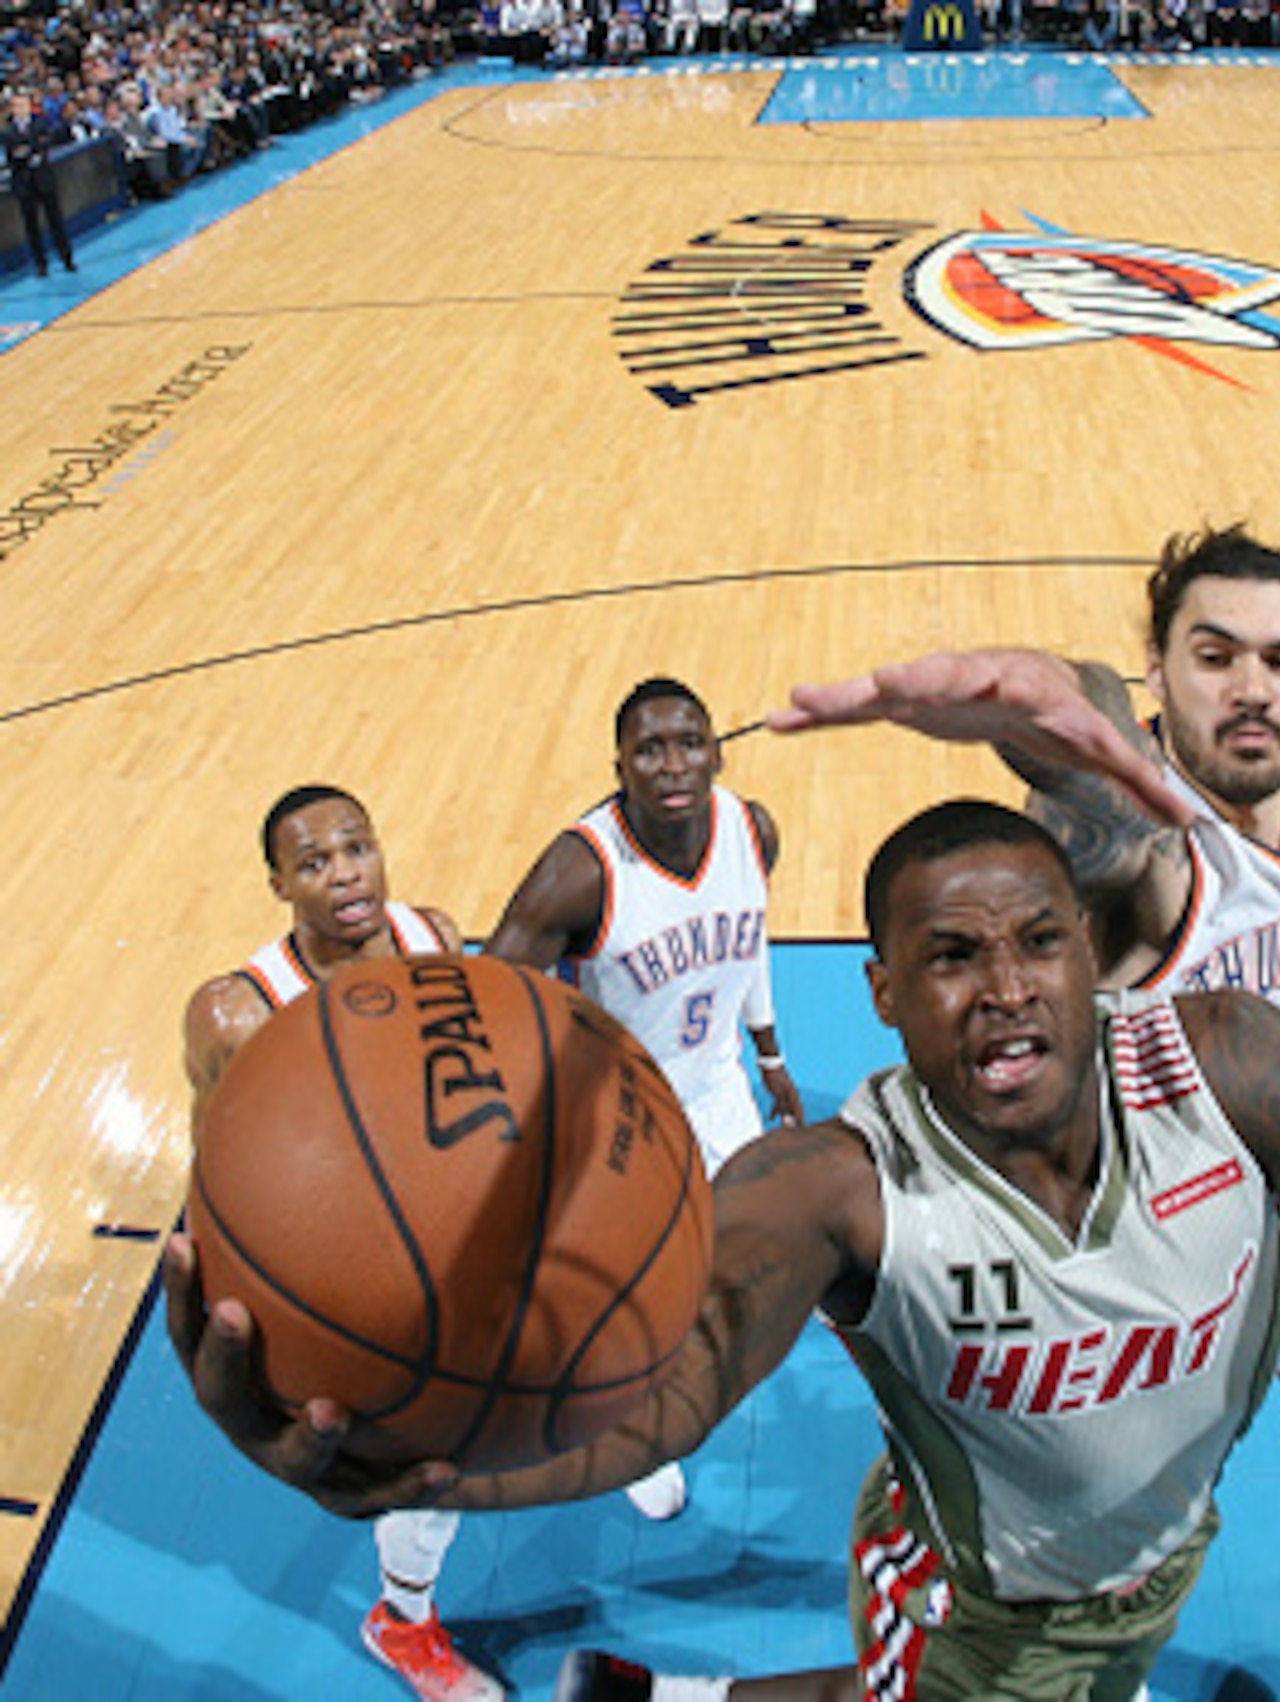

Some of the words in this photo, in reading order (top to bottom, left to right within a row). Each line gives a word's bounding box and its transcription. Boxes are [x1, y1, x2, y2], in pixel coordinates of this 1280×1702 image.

[609, 211, 936, 408] THUNDER
[679, 987, 718, 1050] 5
[946, 1246, 1255, 1414] HEAT
[947, 1259, 1034, 1330] 11
